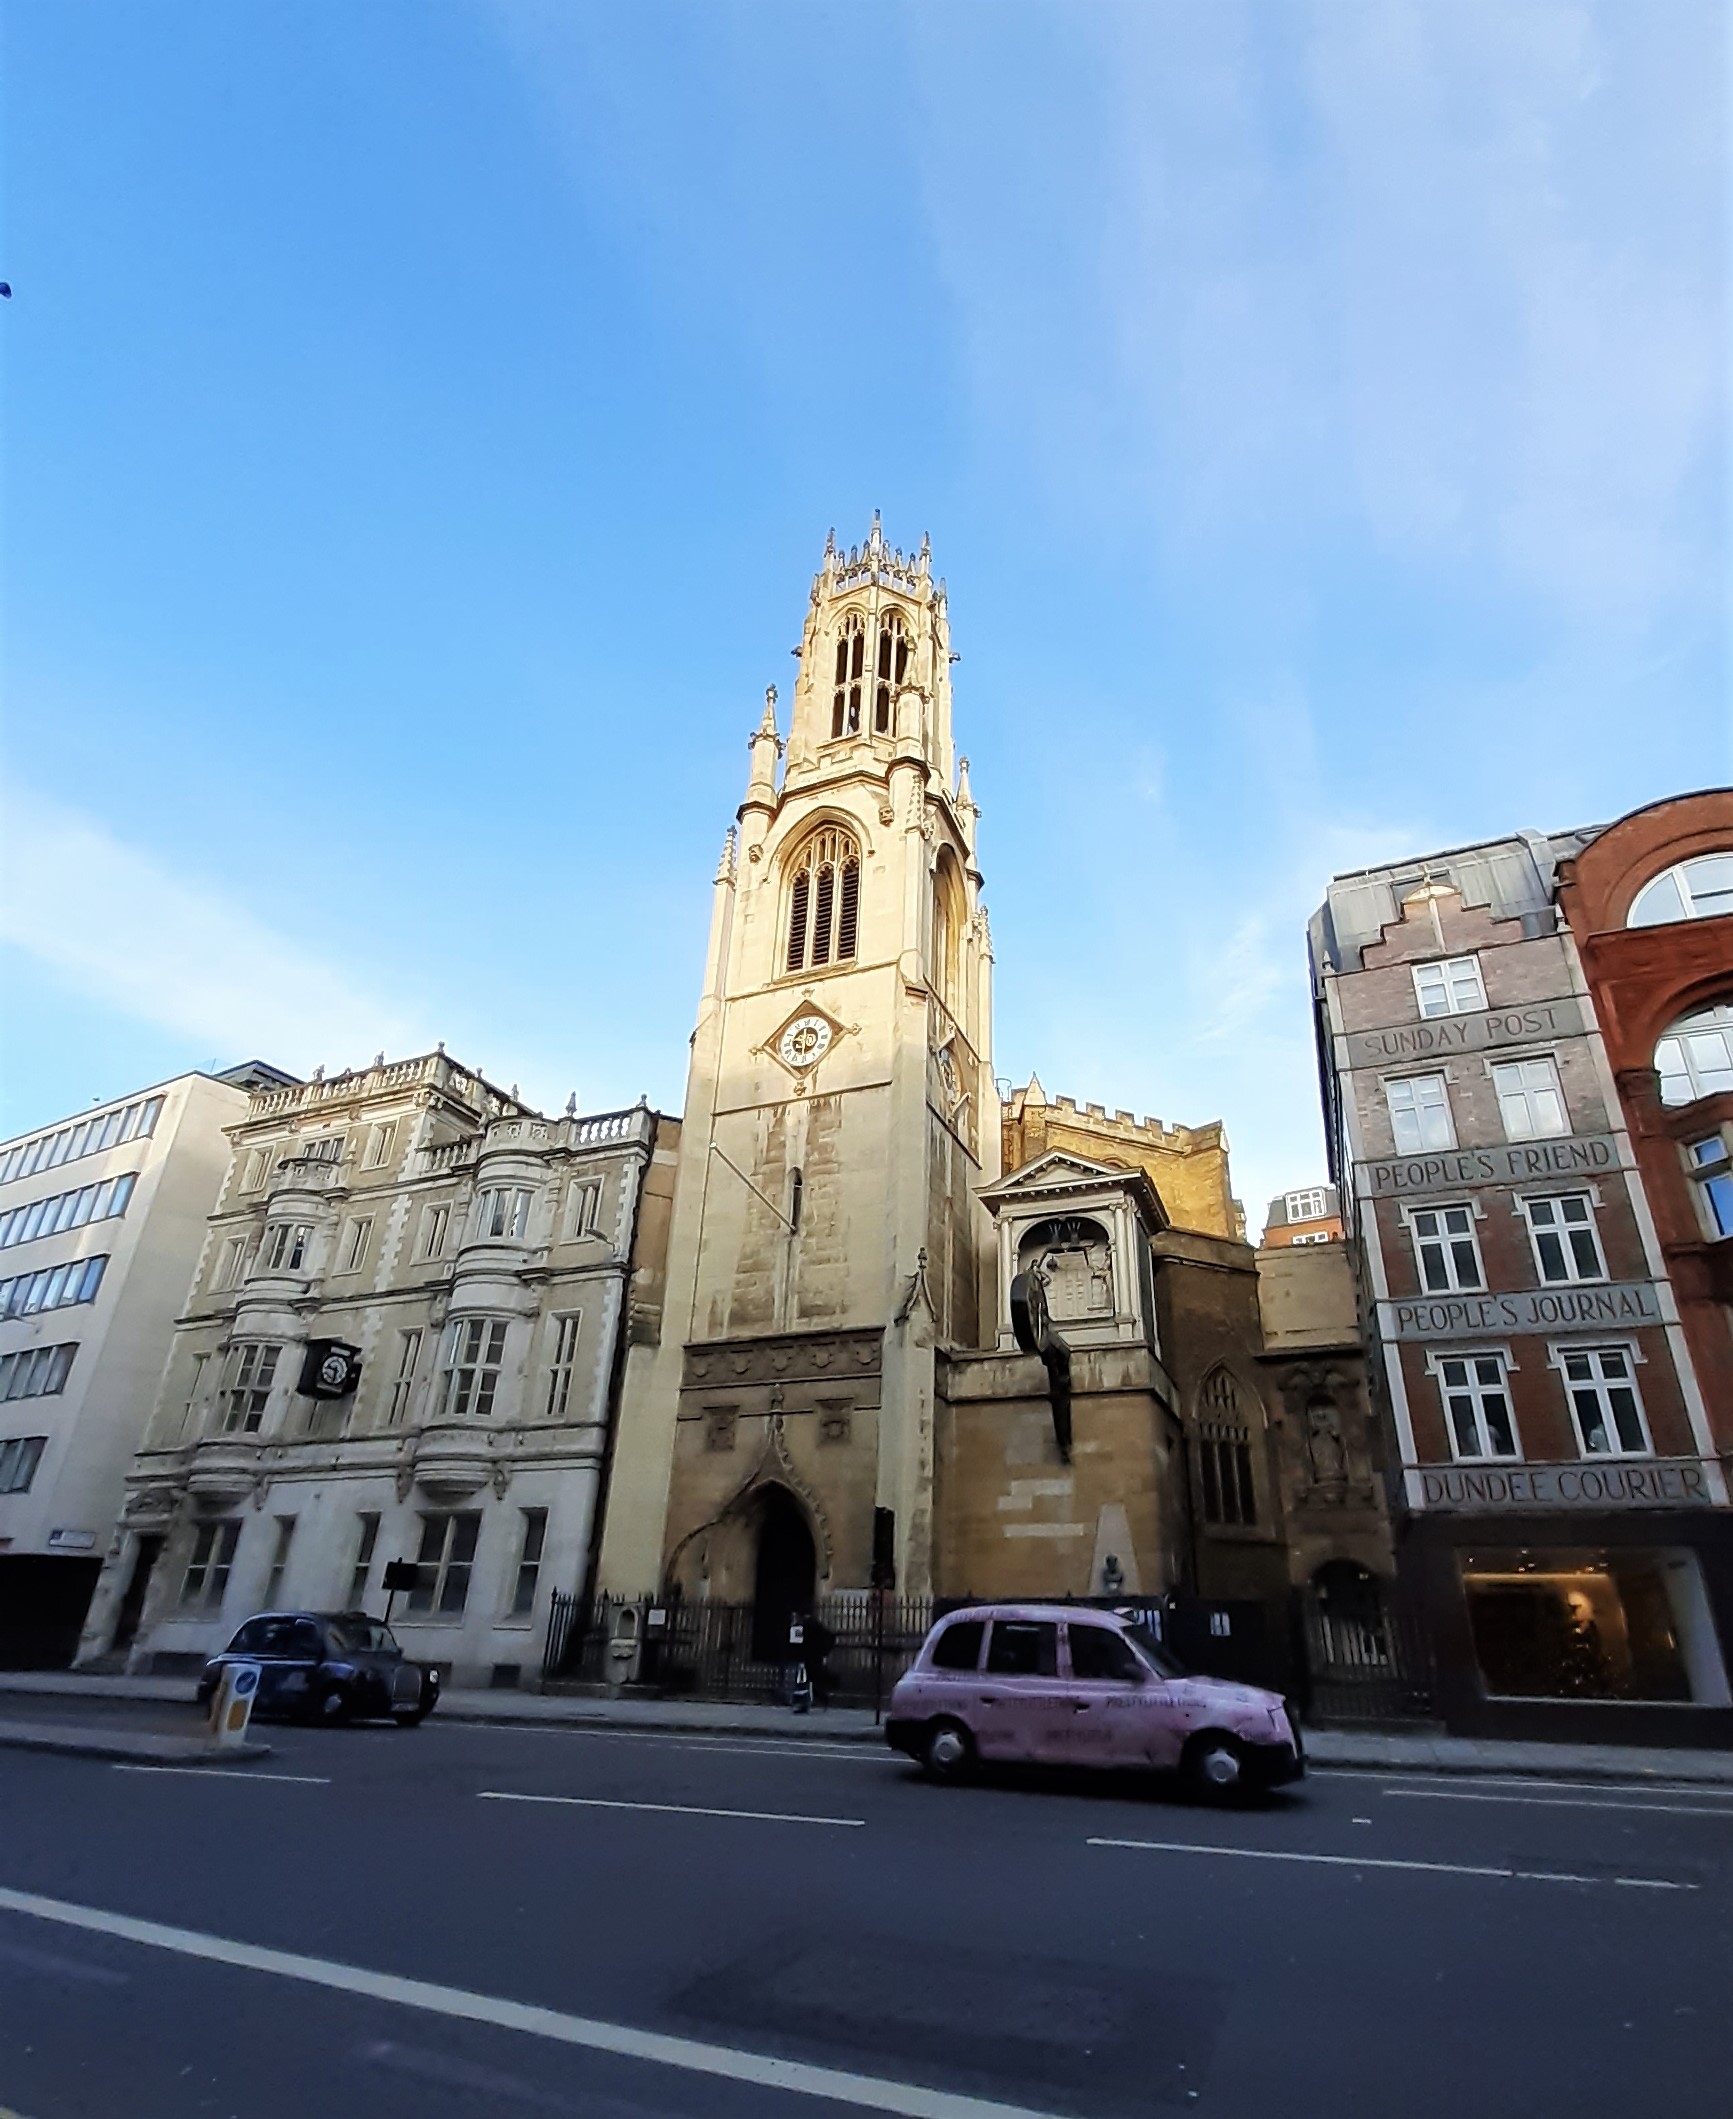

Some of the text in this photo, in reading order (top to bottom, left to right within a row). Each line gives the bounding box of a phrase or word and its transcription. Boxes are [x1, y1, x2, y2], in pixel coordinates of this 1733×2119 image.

[1364, 1008, 1557, 1058] SUNDAY POST
[1374, 1141, 1610, 1190] PEOPLE'S FRIEND
[1398, 1289, 1655, 1332] PEOPLE'S JOURNAL
[1422, 1467, 1706, 1502] DUNDEE COURIER
